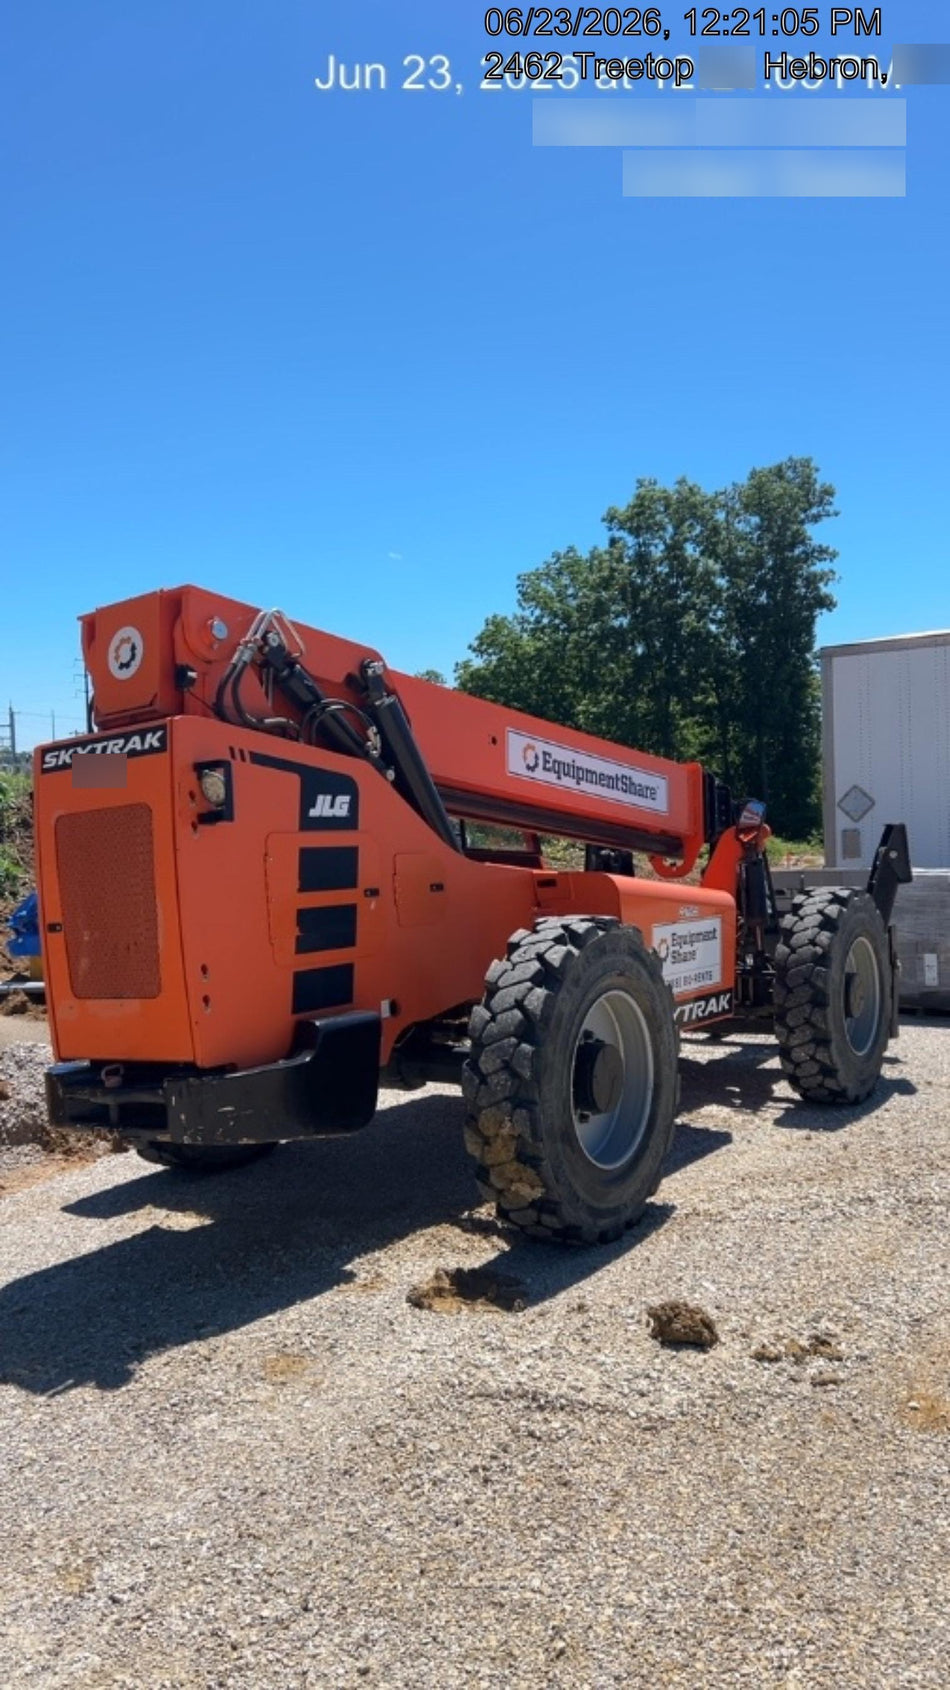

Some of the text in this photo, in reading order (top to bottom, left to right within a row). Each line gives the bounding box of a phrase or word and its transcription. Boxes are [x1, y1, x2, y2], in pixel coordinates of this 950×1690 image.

[542, 750, 657, 801] EquipmentShare
[309, 794, 350, 817] JLG
[671, 928, 718, 949] Equipment
[671, 950, 698, 965] Share
